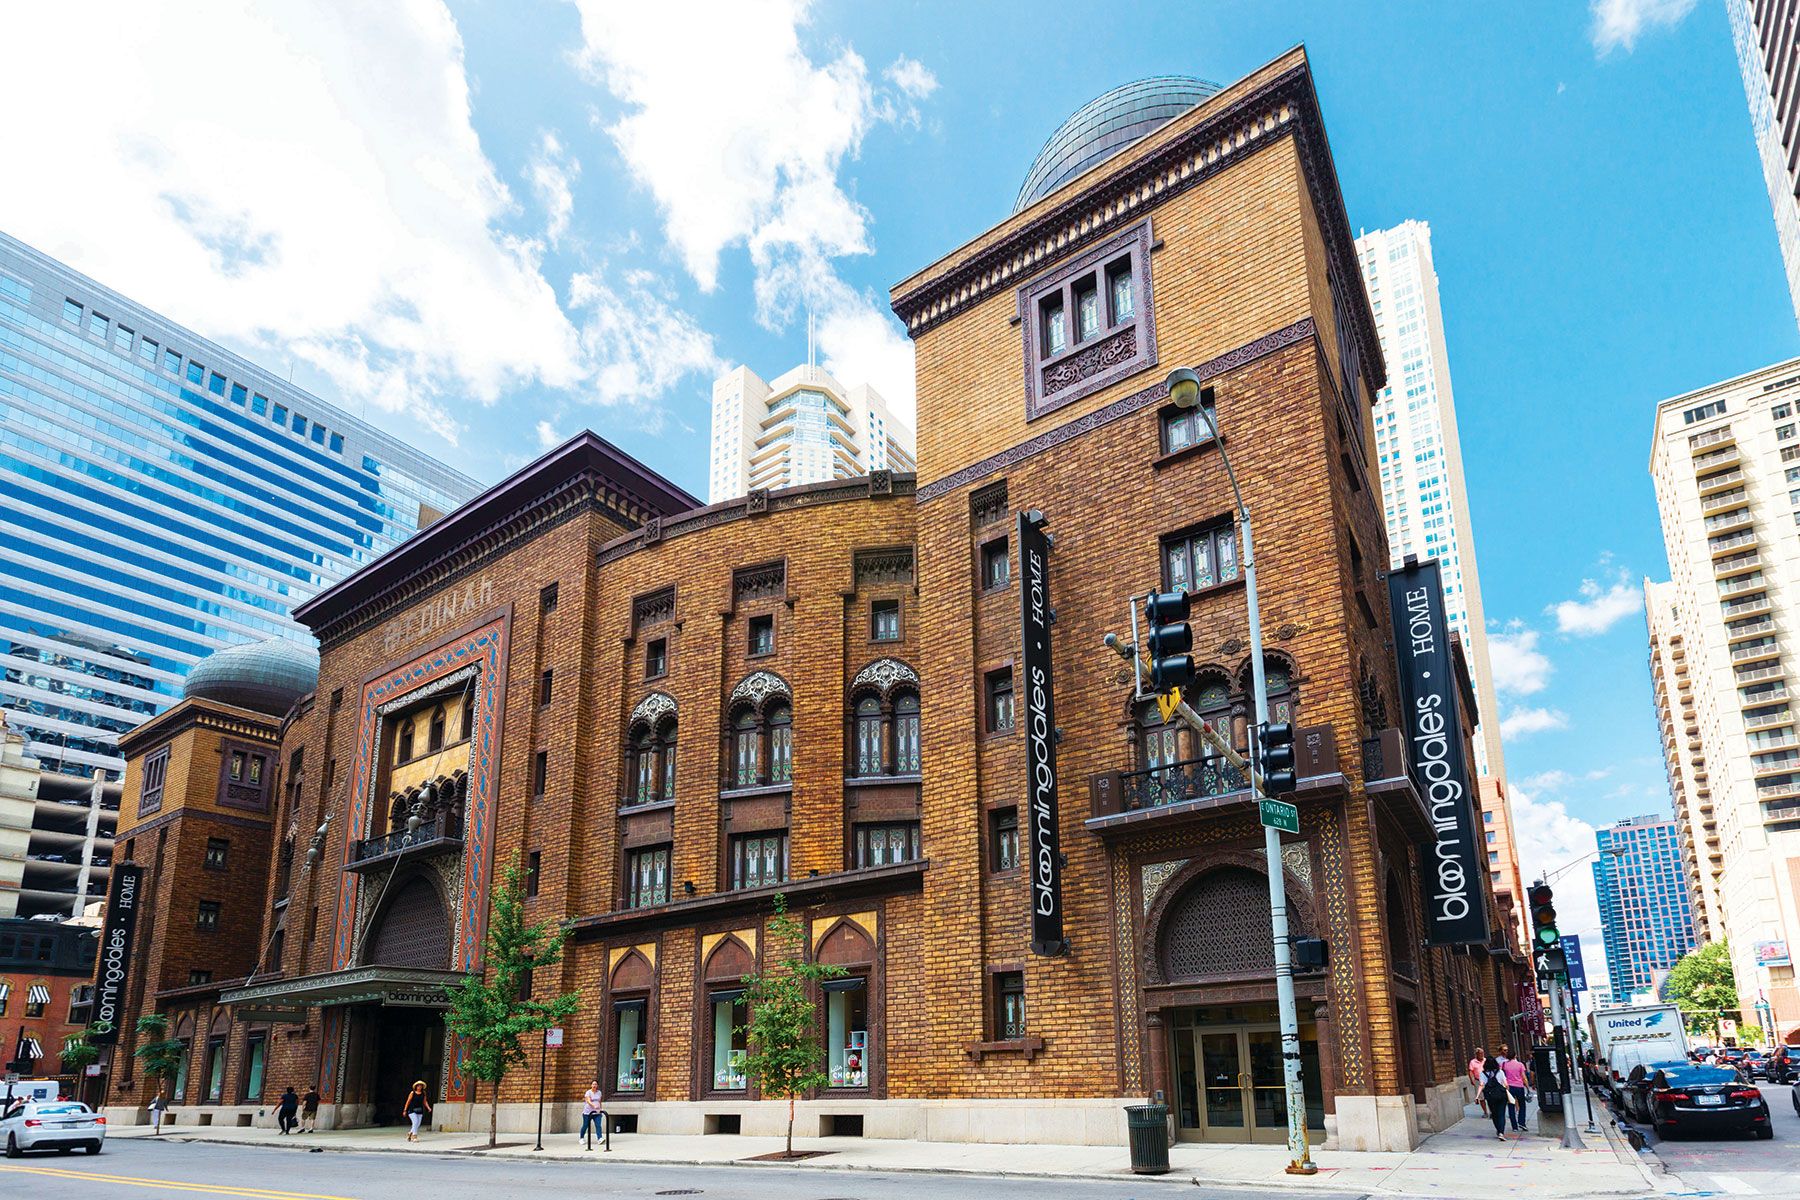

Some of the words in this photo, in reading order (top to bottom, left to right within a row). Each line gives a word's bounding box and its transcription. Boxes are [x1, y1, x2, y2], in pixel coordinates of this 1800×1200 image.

[1031, 549, 1043, 629] HOME
[1406, 586, 1436, 658] HOME
[1265, 802, 1290, 818] ONTARIO
[119, 875, 136, 909] HOME
[388, 990, 453, 1004] bloomingdale
[1608, 1017, 1642, 1028] United
